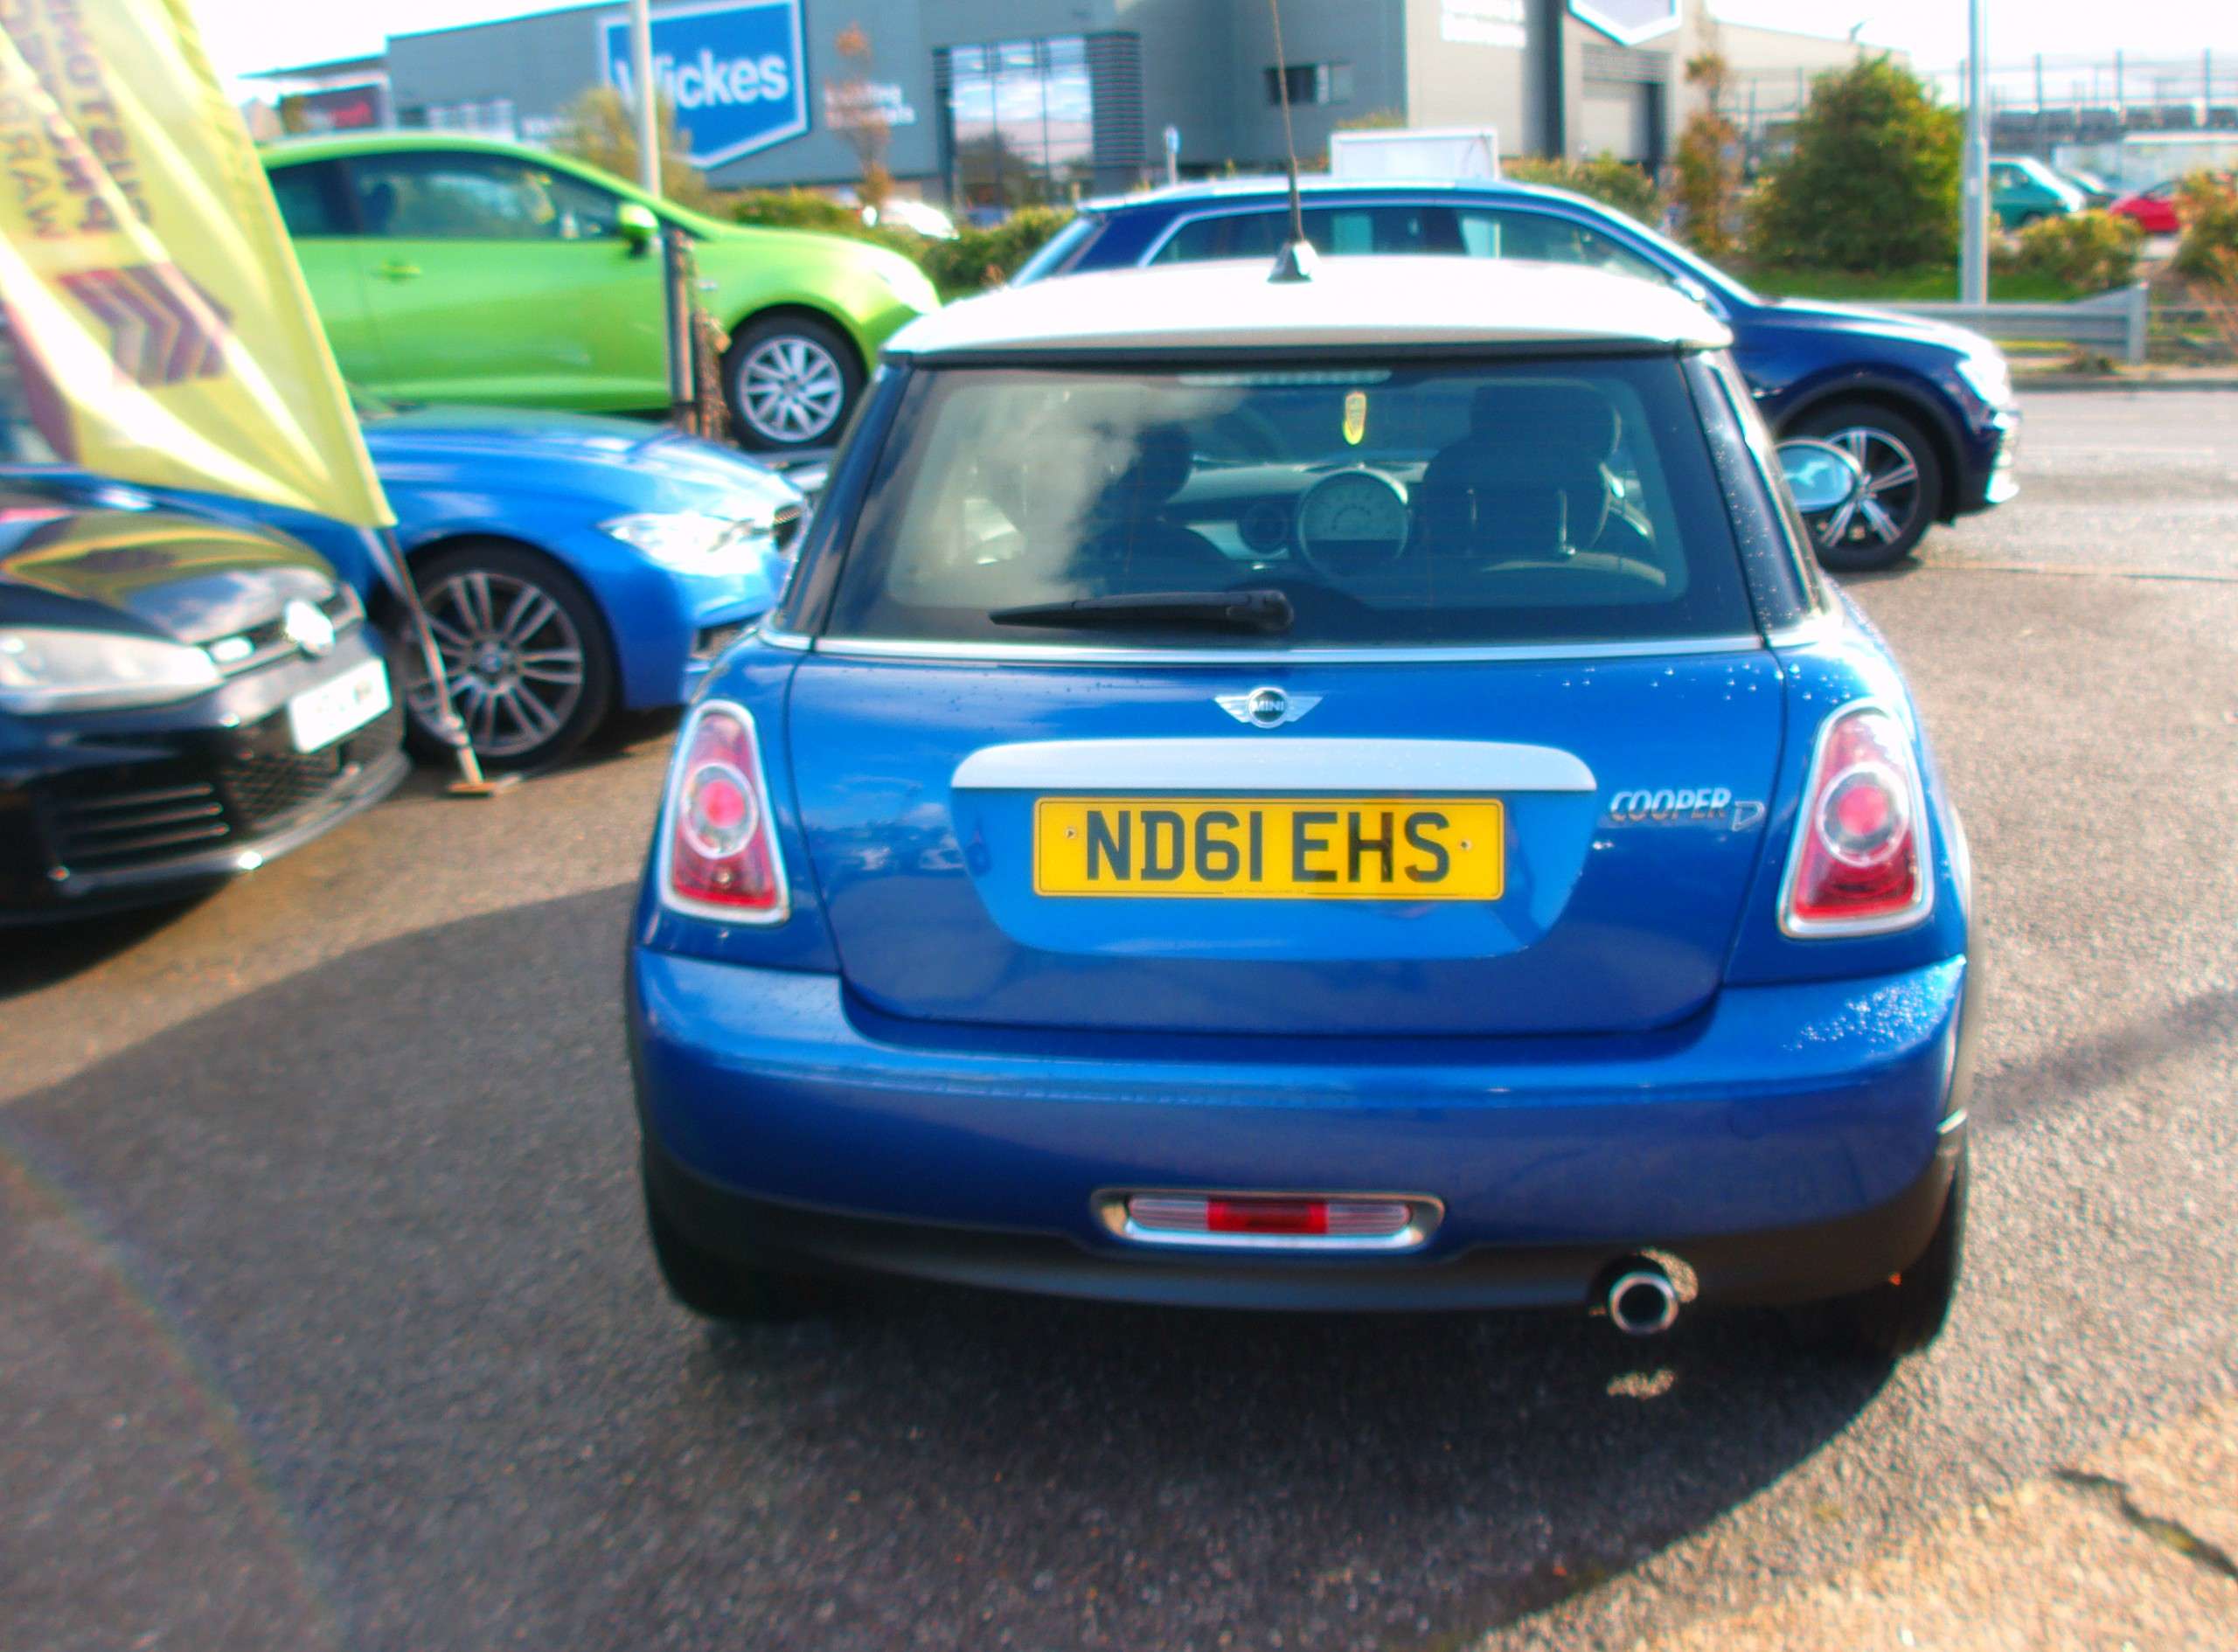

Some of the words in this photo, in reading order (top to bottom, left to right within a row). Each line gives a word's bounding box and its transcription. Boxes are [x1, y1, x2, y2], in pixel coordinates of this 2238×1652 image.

[1251, 699, 1284, 712] MINI
[1609, 787, 1732, 823] COOPER
[1732, 800, 1766, 832] D
[1086, 809, 1263, 882] ND61
[1291, 811, 1450, 883] EHS
